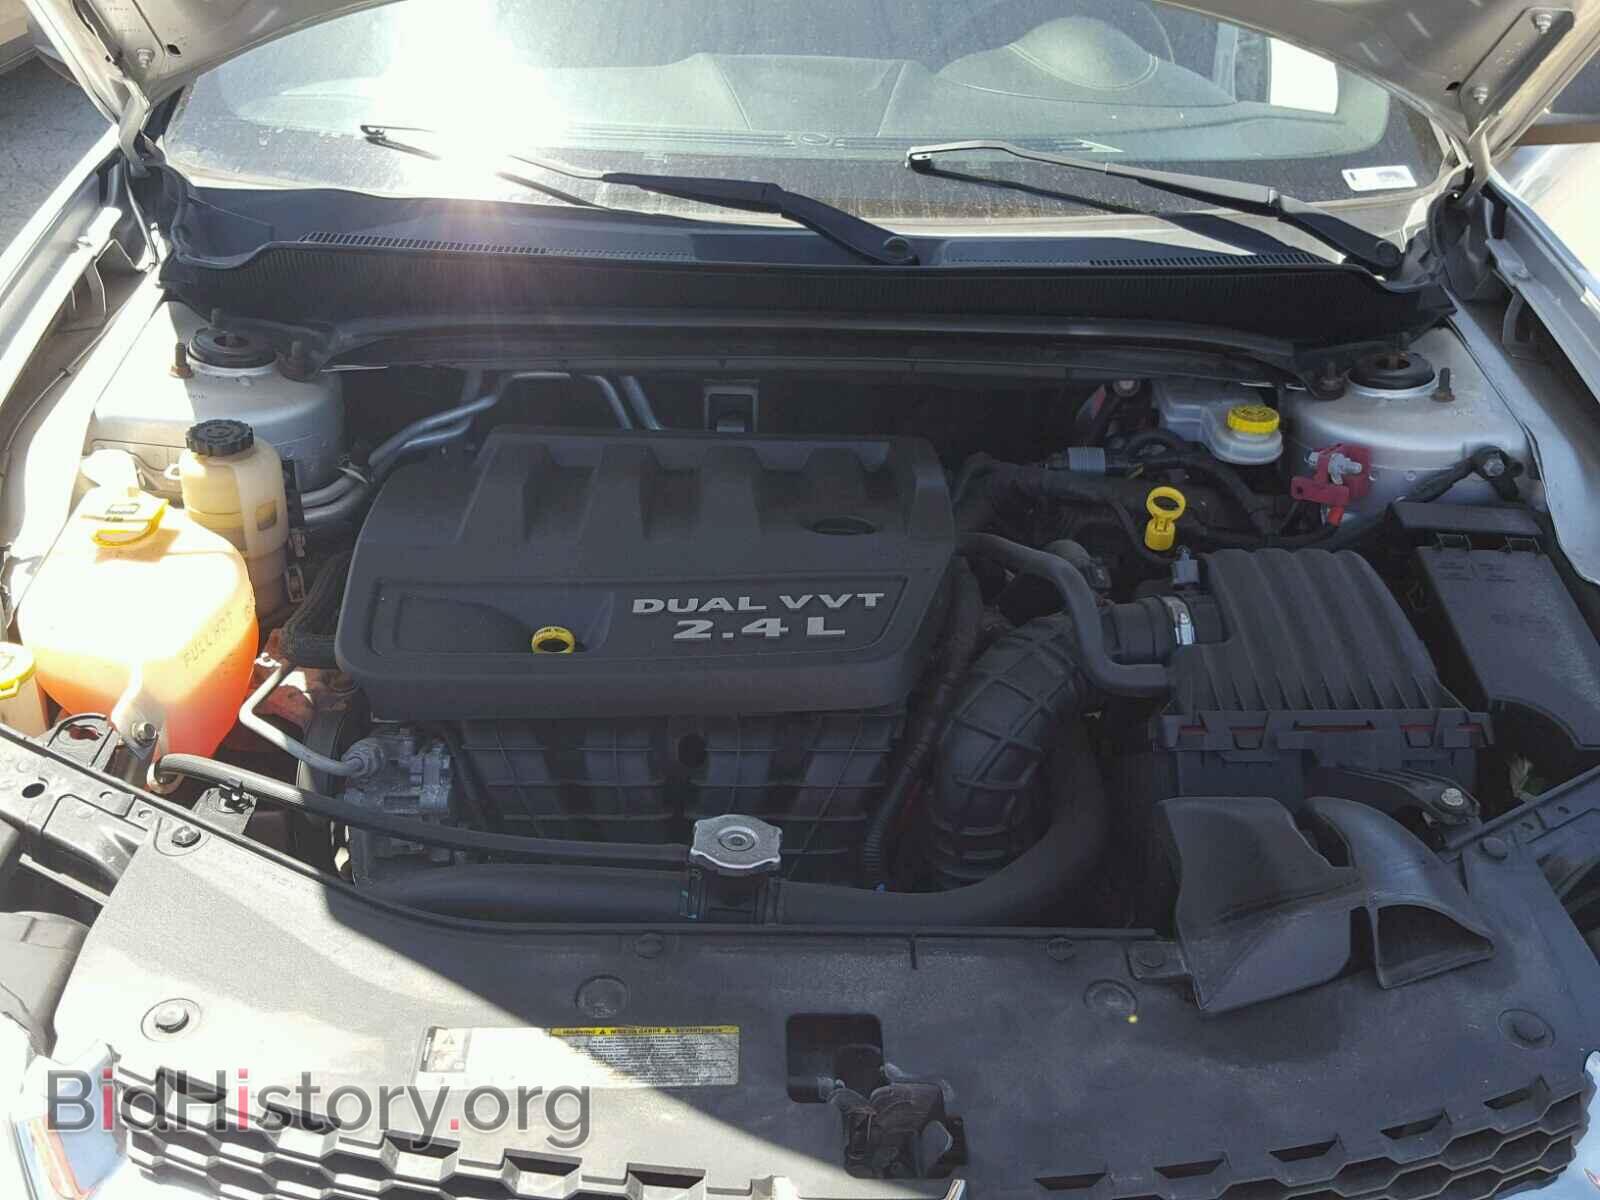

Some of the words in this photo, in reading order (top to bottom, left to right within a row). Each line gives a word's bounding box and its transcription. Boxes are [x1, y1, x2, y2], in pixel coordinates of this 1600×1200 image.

[632, 596, 767, 613] DUAL
[779, 592, 885, 608] VVT
[673, 617, 789, 639] 2.4
[806, 616, 846, 636] L
